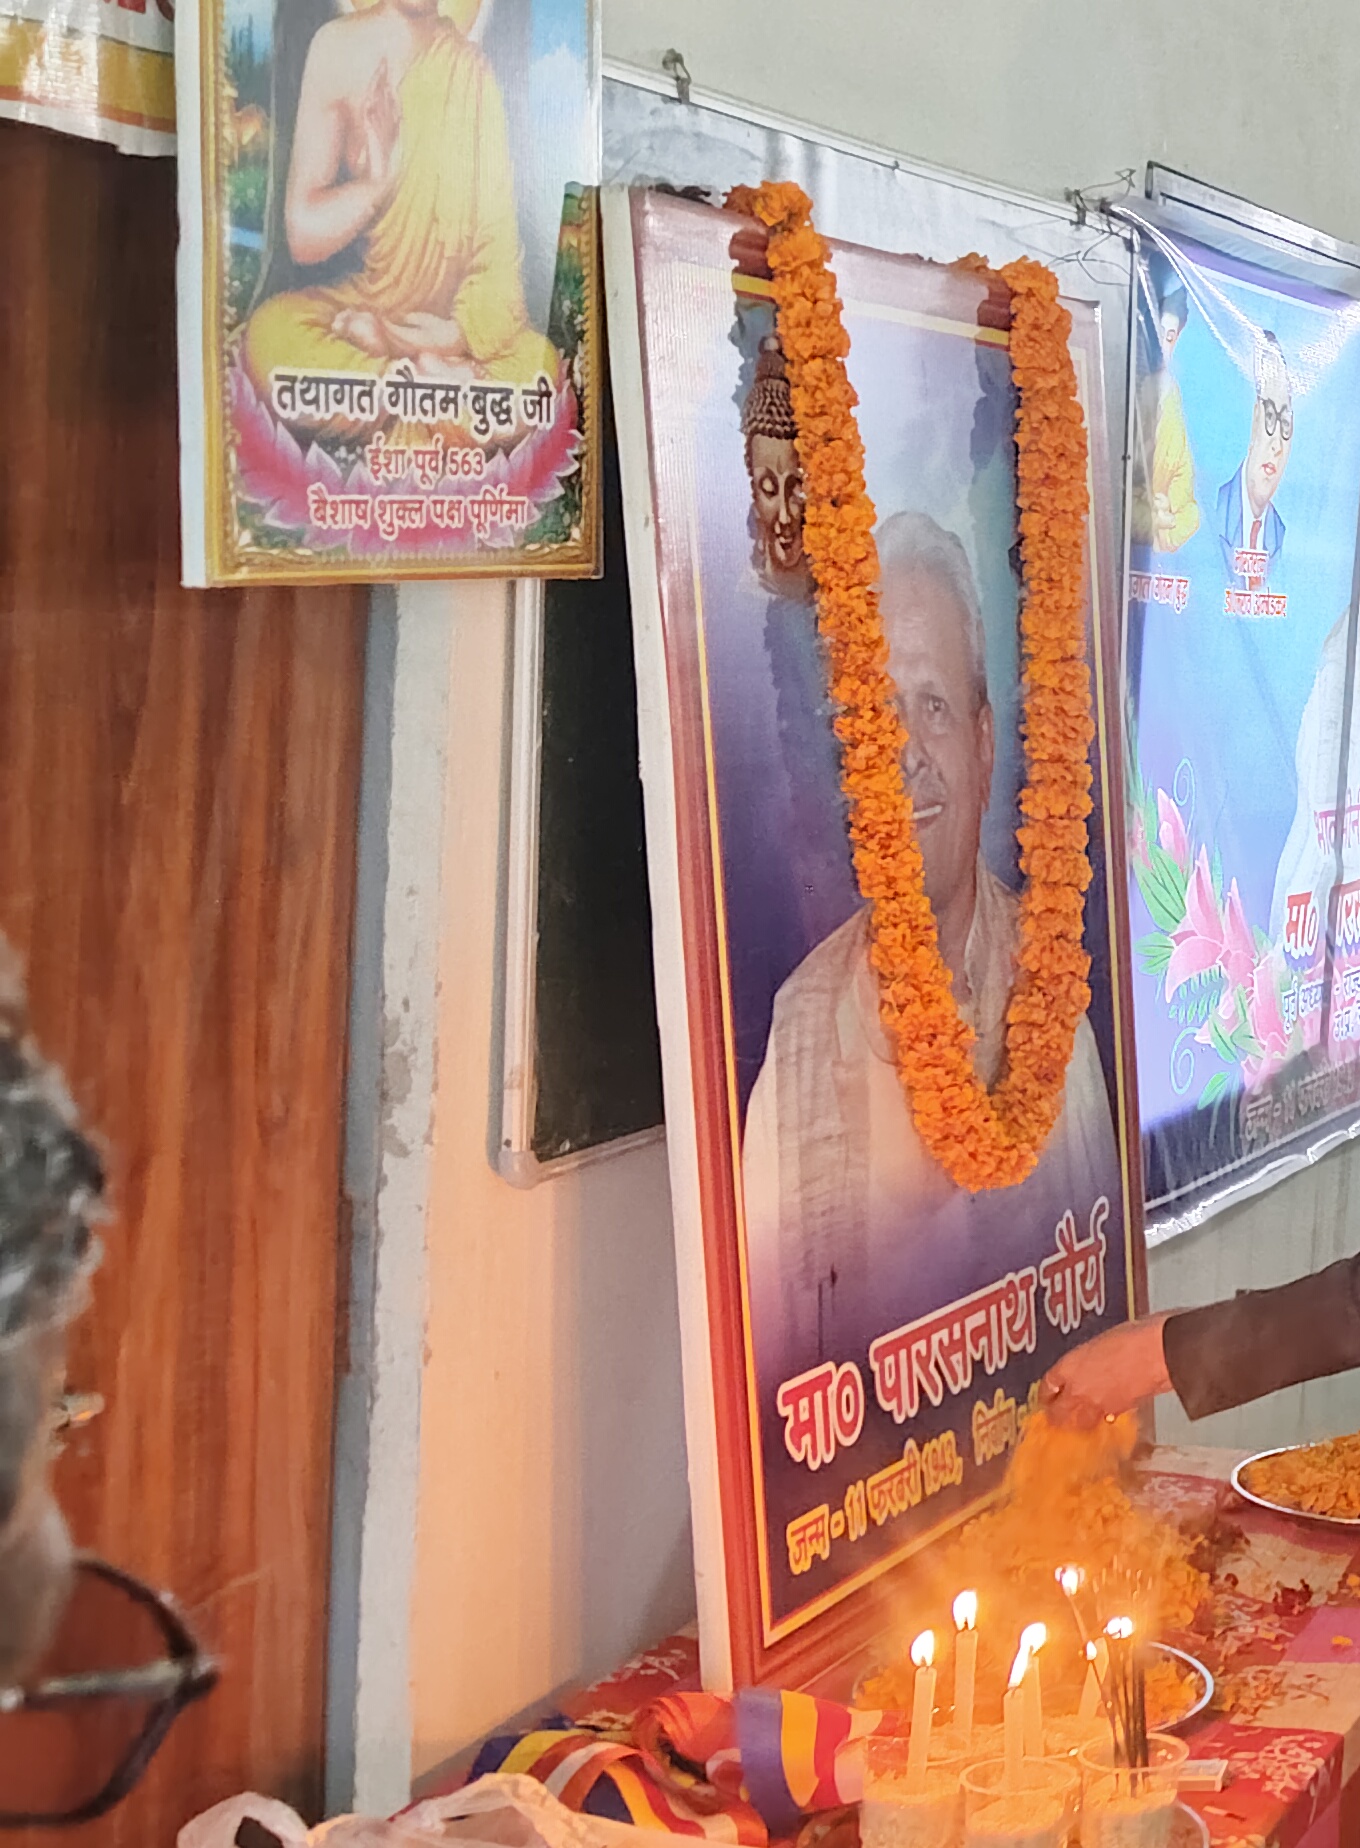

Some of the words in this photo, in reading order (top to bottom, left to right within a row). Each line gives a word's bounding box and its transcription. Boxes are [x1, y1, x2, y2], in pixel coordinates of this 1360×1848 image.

[274, 374, 376, 417] तथागत
[384, 365, 461, 419] गौतम
[469, 384, 514, 435] बुद्ध
[521, 376, 553, 424] जी
[369, 433, 406, 481] ईशा
[413, 436, 443, 486] पूर्व
[449, 450, 484, 476] 563
[376, 497, 425, 537] शुक्ल
[430, 497, 465, 527] पक्ष
[469, 486, 528, 535] पूर्णिमा
[777, 1361, 864, 1470] मा०
[870, 1266, 1037, 1423] पारसनाथ
[1040, 1196, 1109, 1333] मौर्य
[787, 1504, 829, 1574] जन्म
[867, 1437, 921, 1526] फरवरी
